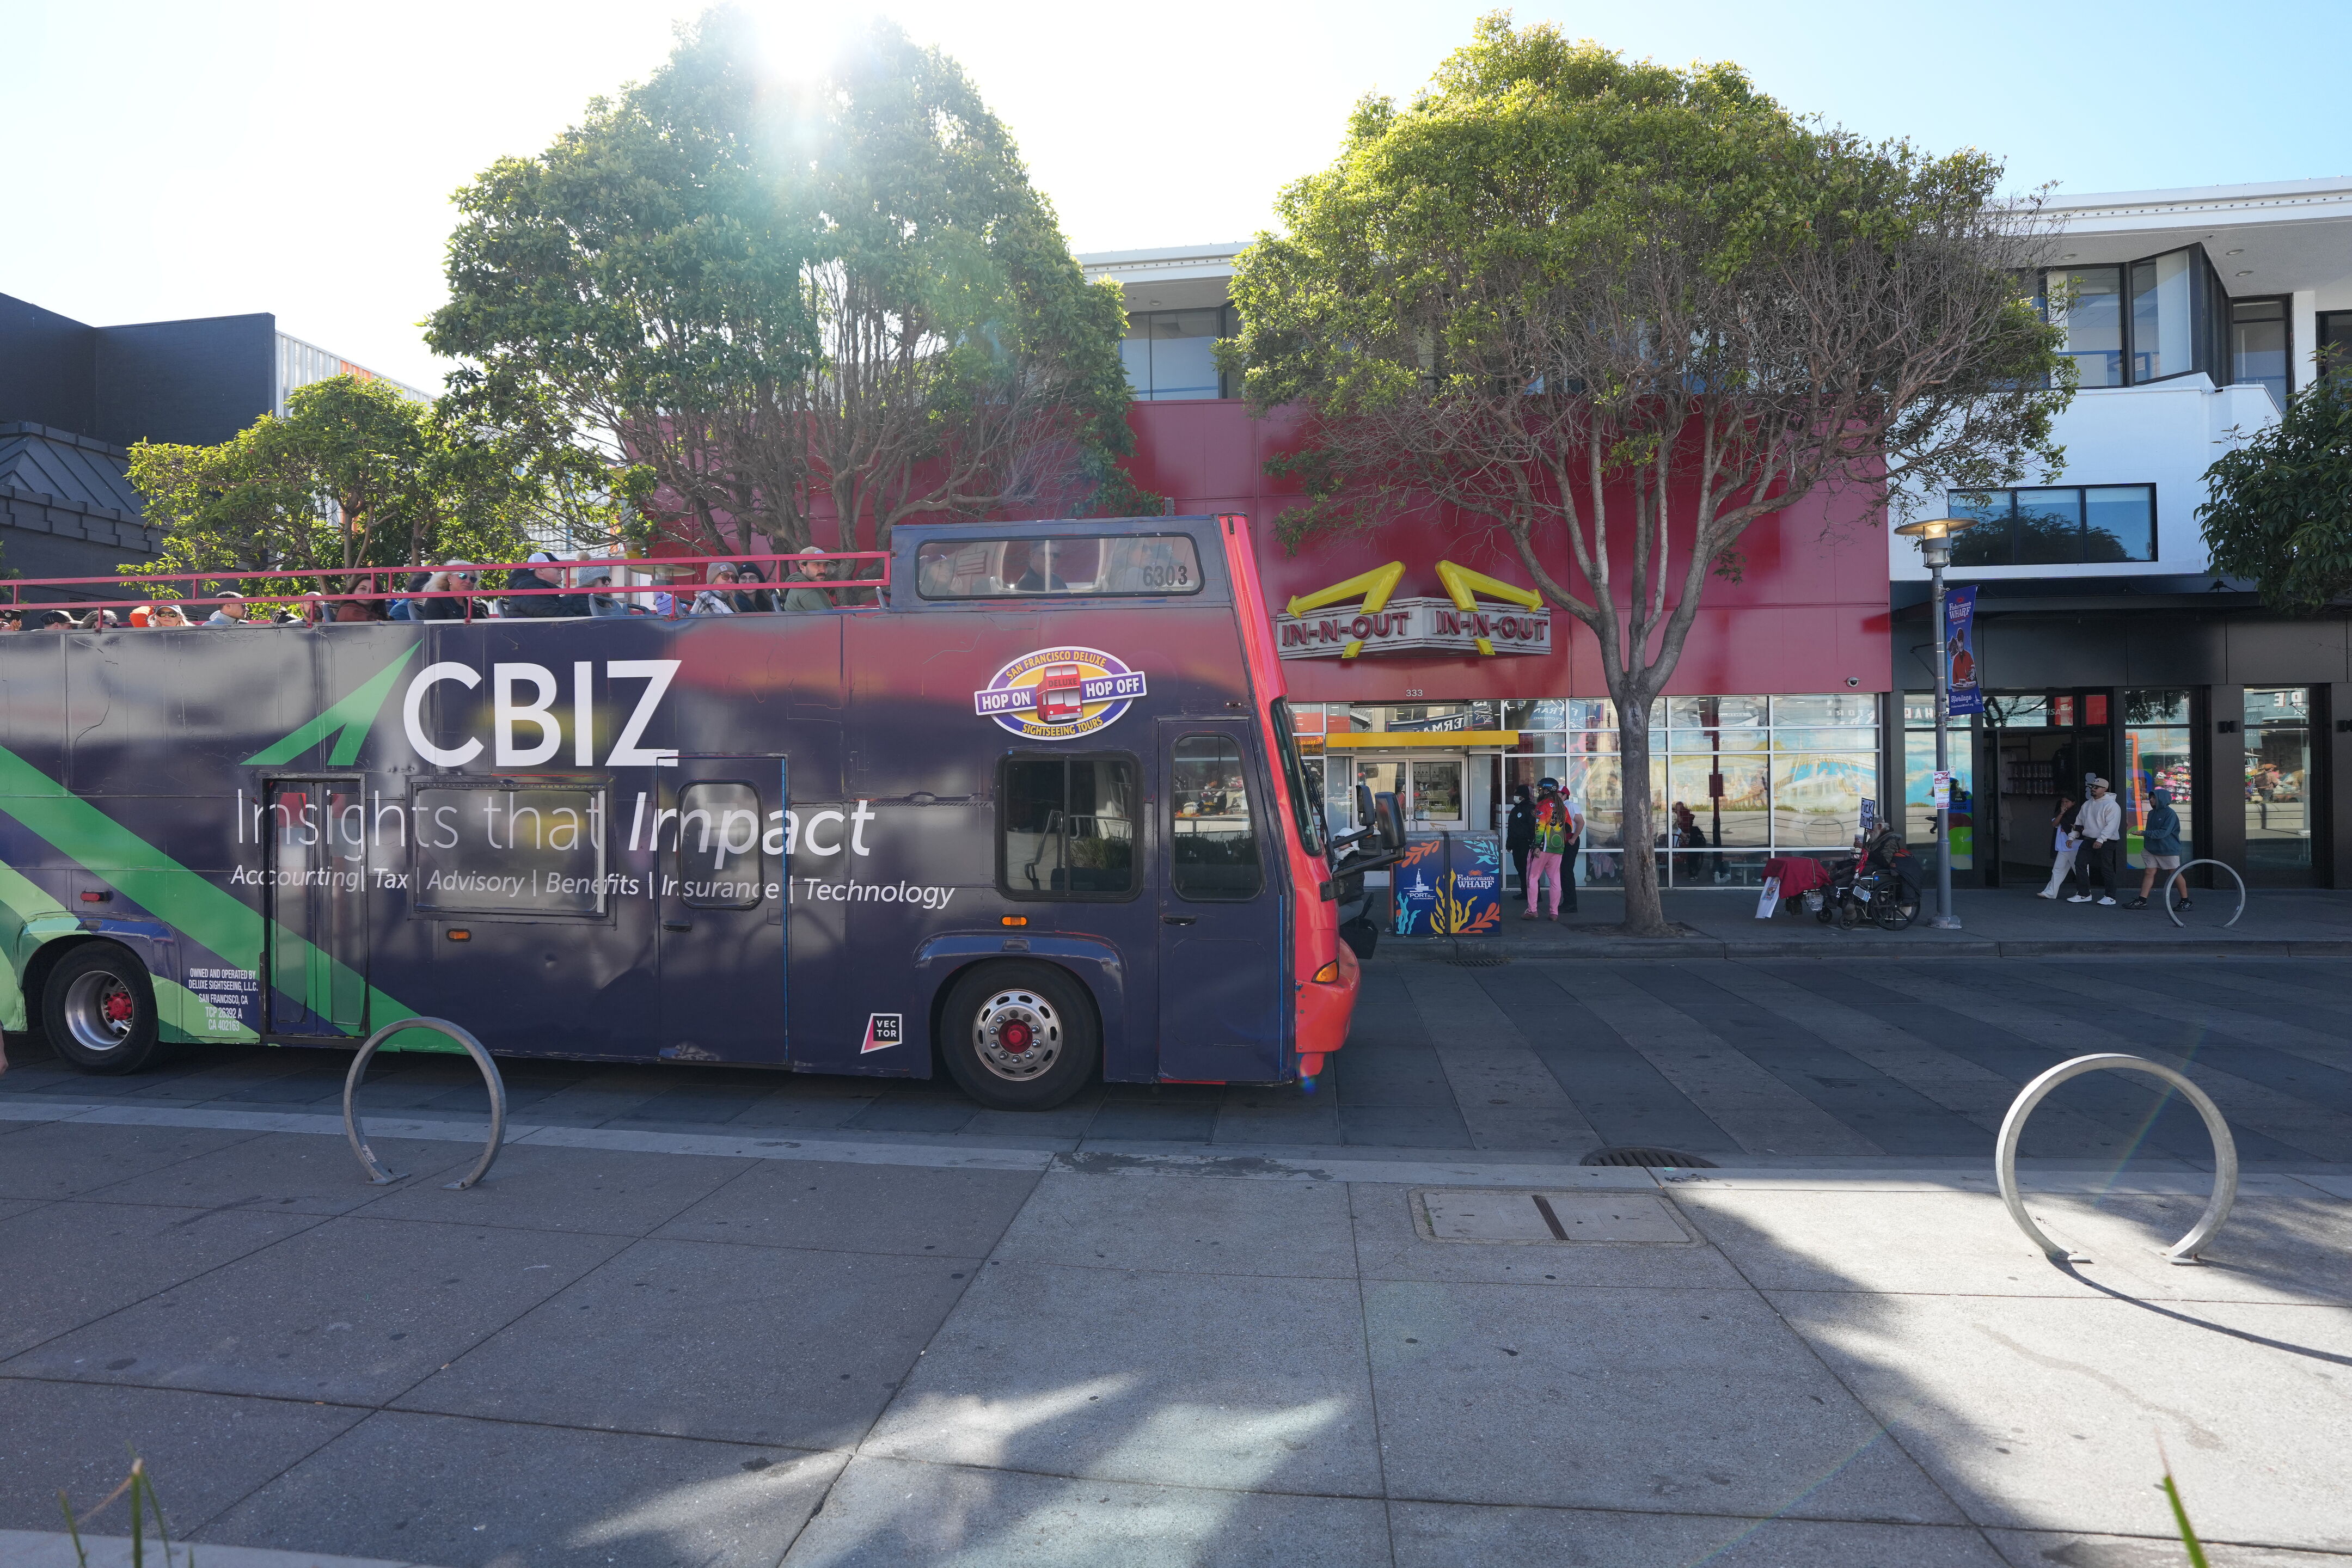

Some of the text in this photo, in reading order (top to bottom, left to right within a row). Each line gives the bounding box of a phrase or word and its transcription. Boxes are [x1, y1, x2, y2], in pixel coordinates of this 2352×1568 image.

[1143, 565, 1187, 586] 6303
[1949, 601, 1971, 611] Fisherman's
[1949, 607, 1971, 619] WHARF
[1282, 611, 1412, 647] IN-N-OUT
[1433, 610, 1548, 641] IN-N-OUT
[1006, 651, 1107, 680] SAN FRANCISCO DELUXE
[1049, 678, 1077, 687] DELUXE
[1085, 677, 1140, 698] HOP OFF
[1406, 689, 1423, 697] 333
[1951, 695, 1972, 703] Heritage
[982, 691, 1031, 710] HOP ON
[403, 659, 682, 767] CBIZ
[1022, 716, 1104, 737] SIGHTSEEING TOURS
[1860, 813, 1873, 828] TRUMP
[238, 789, 875, 869] Insights that Impact
[230, 865, 955, 909] Accounting Tax Advisory Benefits Insurance Technology
[1457, 881, 1494, 890] WHARF
[190, 968, 256, 979] OWNED AND OPERATED BY
[188, 979, 258, 993] DELUXE SIGHTSEEING, L.L.C.
[199, 993, 248, 1006] SAN FRANCISCO, CA
[205, 1006, 242, 1019] TCP 26392 A
[209, 1019, 240, 1031] CA 402163
